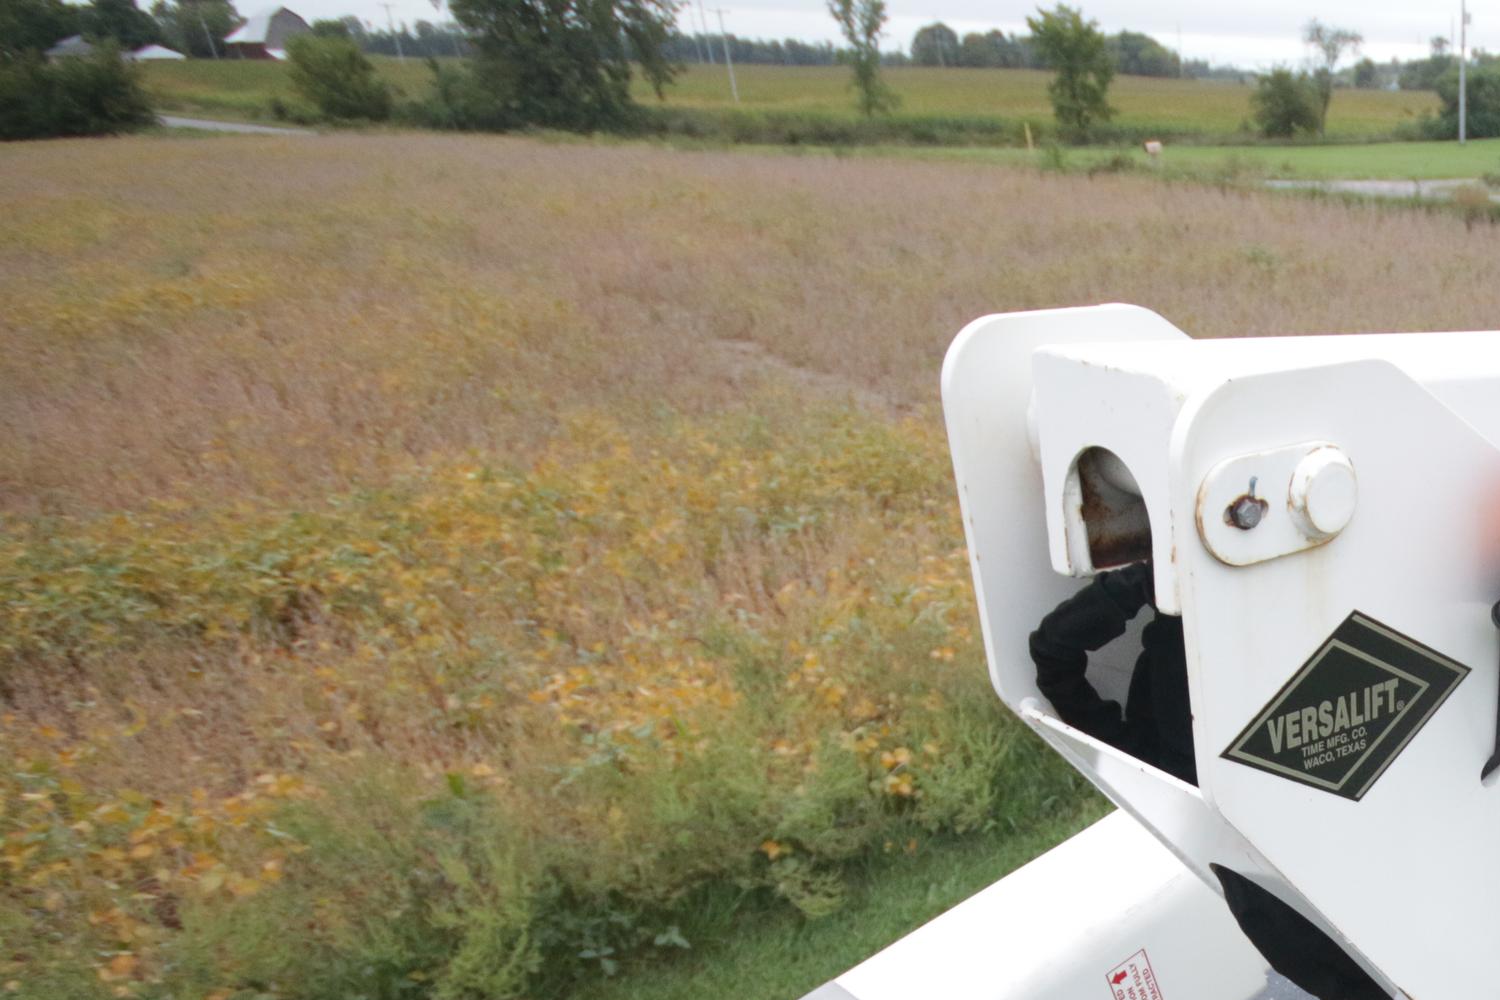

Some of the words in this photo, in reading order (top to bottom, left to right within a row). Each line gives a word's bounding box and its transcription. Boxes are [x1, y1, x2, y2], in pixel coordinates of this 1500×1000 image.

[1267, 678, 1399, 754] VERSALIFT
[1302, 741, 1325, 758] TIME
[1326, 733, 1350, 749] MFG.
[1351, 726, 1368, 740] CO.
[1304, 752, 1335, 770] WACO,
[1336, 739, 1367, 758] TEXAS
[1129, 963, 1143, 987] FULLY
